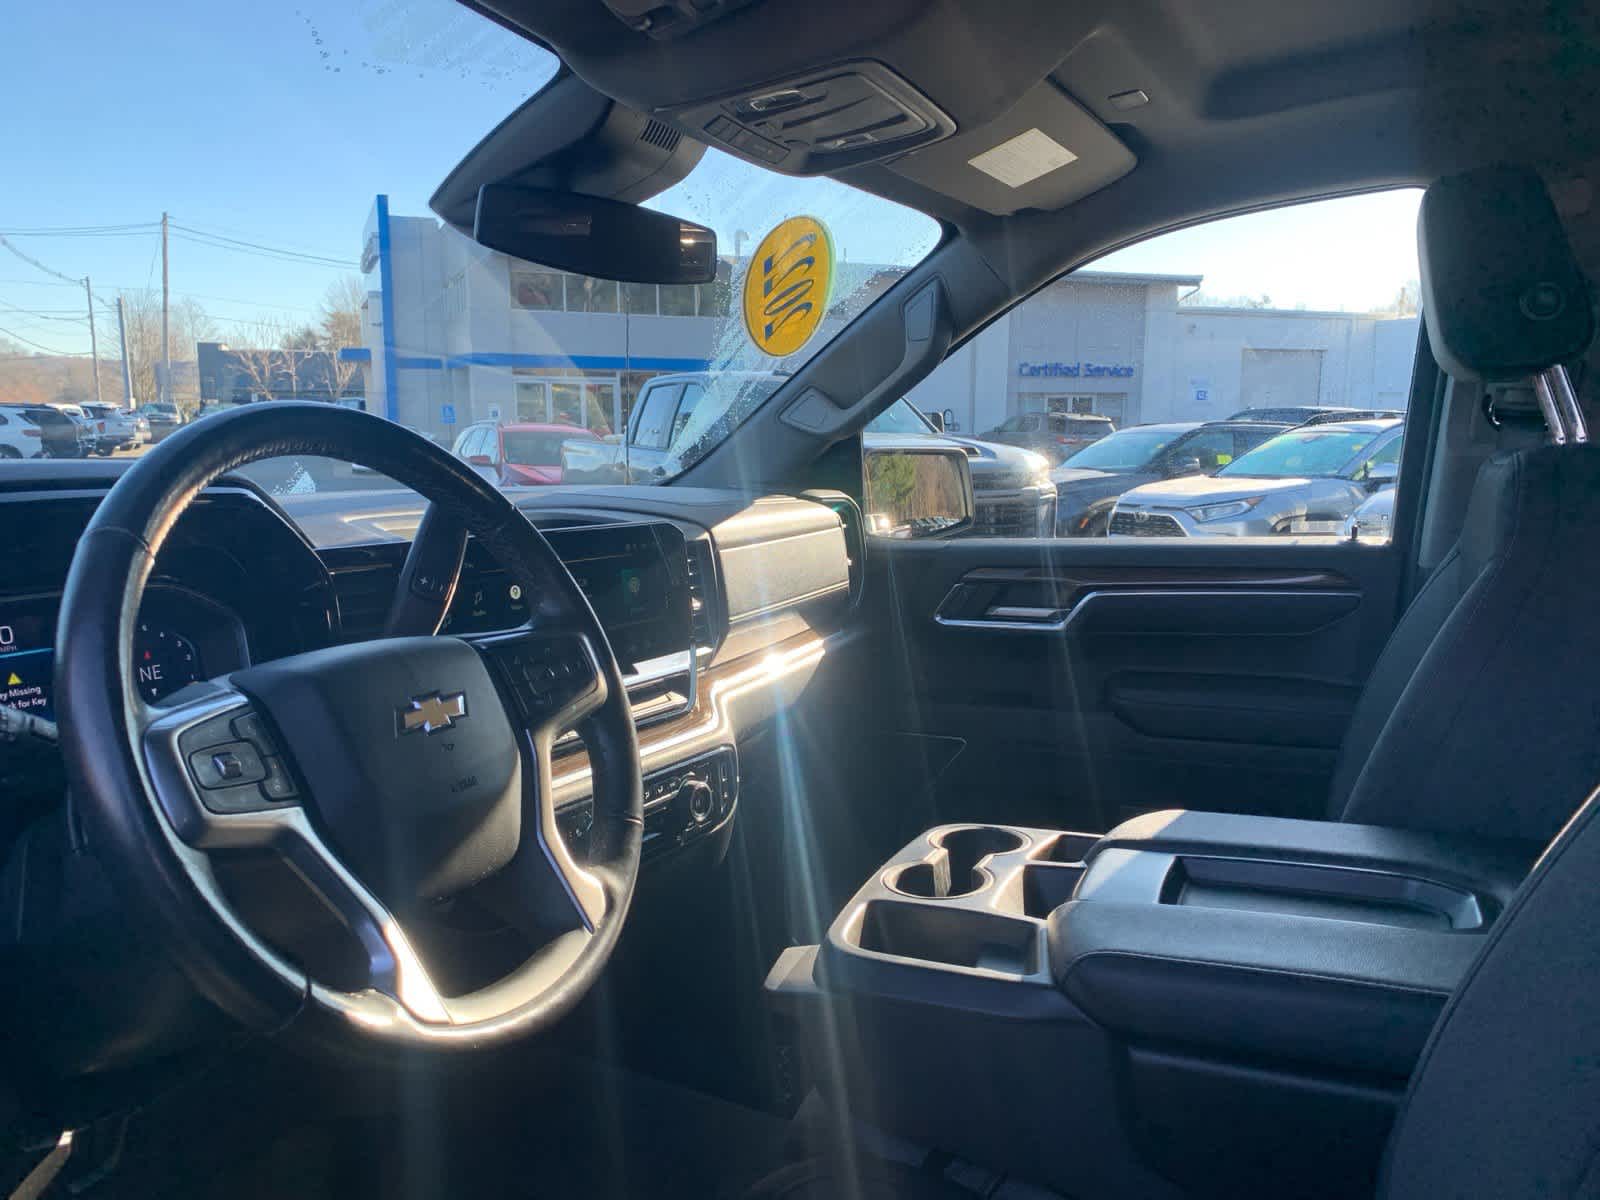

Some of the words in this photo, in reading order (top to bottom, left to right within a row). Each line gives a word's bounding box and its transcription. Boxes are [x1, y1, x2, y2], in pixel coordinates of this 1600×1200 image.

[1019, 362, 1080, 377] Certified
[1084, 363, 1134, 377] Service
[139, 664, 163, 683] NE
[9, 687, 41, 697] Missing
[18, 700, 30, 709] for
[32, 697, 47, 706] Key
